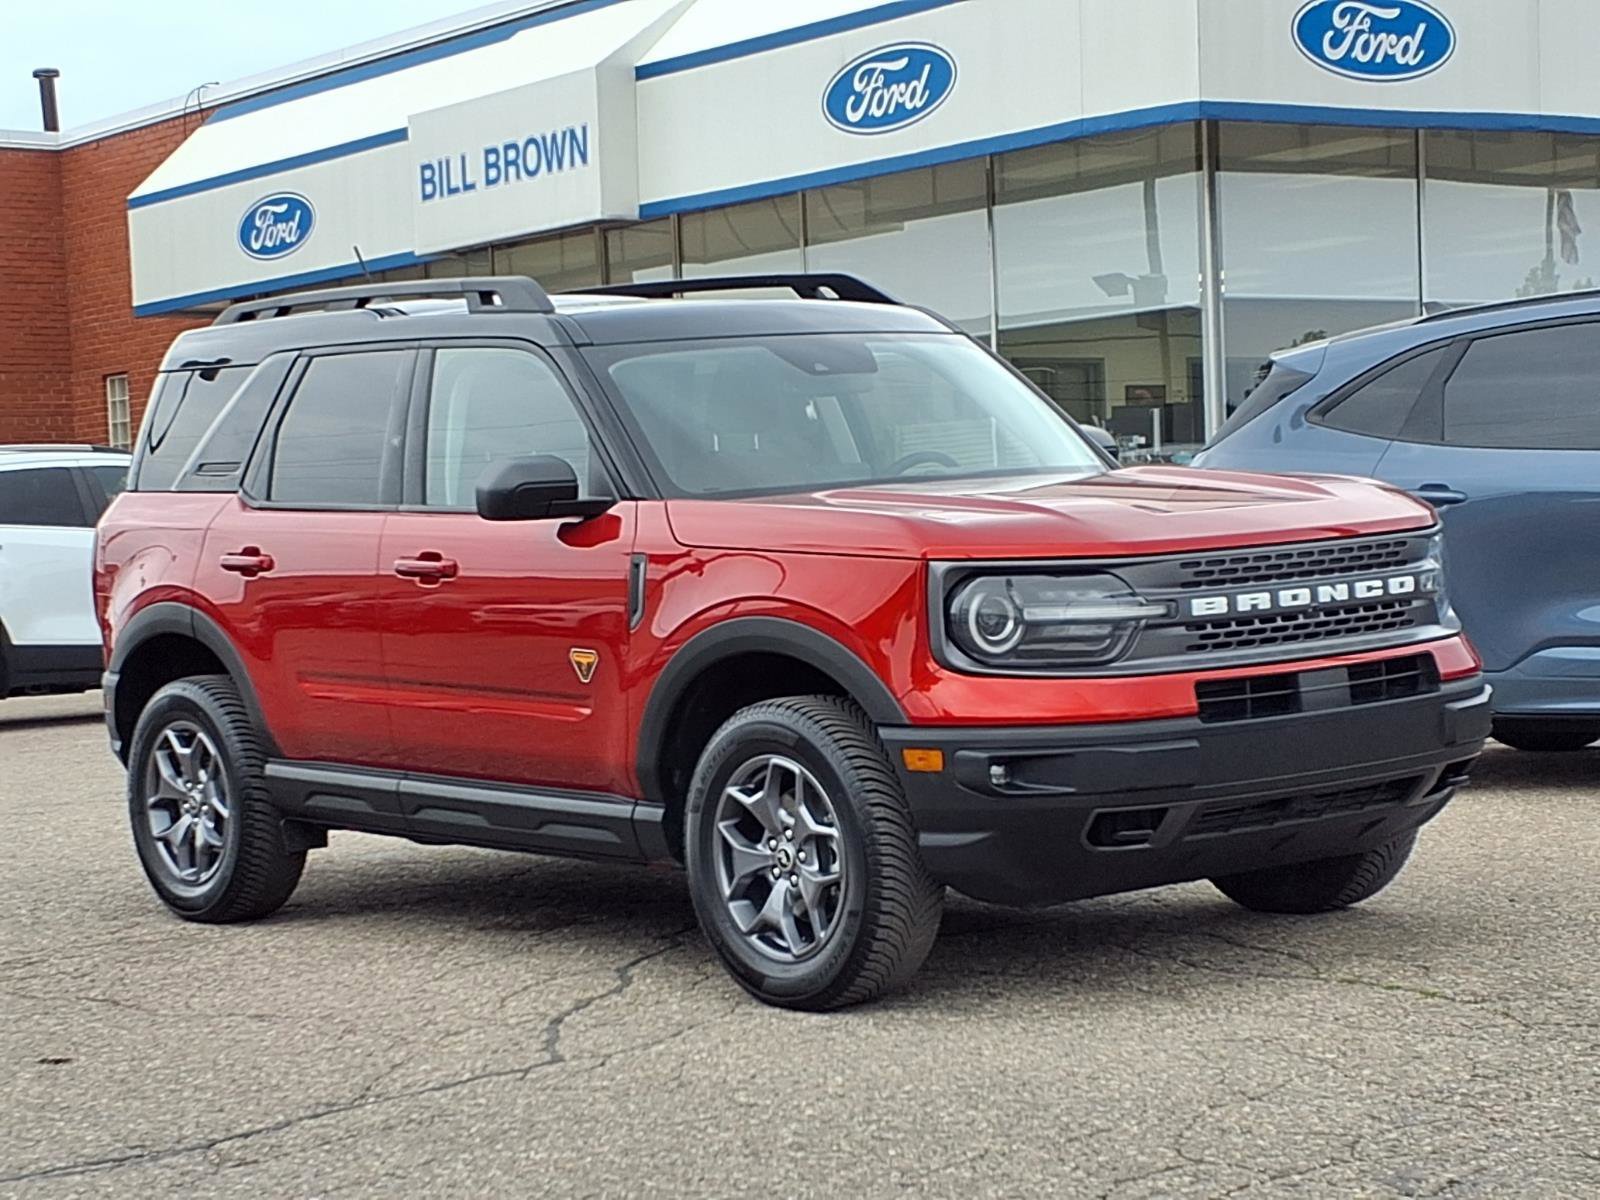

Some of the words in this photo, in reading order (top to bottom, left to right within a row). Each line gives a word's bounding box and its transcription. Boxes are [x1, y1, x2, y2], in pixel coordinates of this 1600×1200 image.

[1322, 1, 1427, 66] Ford
[846, 56, 931, 123] Ford
[420, 154, 476, 201] BILL
[484, 124, 588, 187] BROWN
[250, 203, 301, 250] Ford
[1191, 576, 1415, 616] BRONCO
